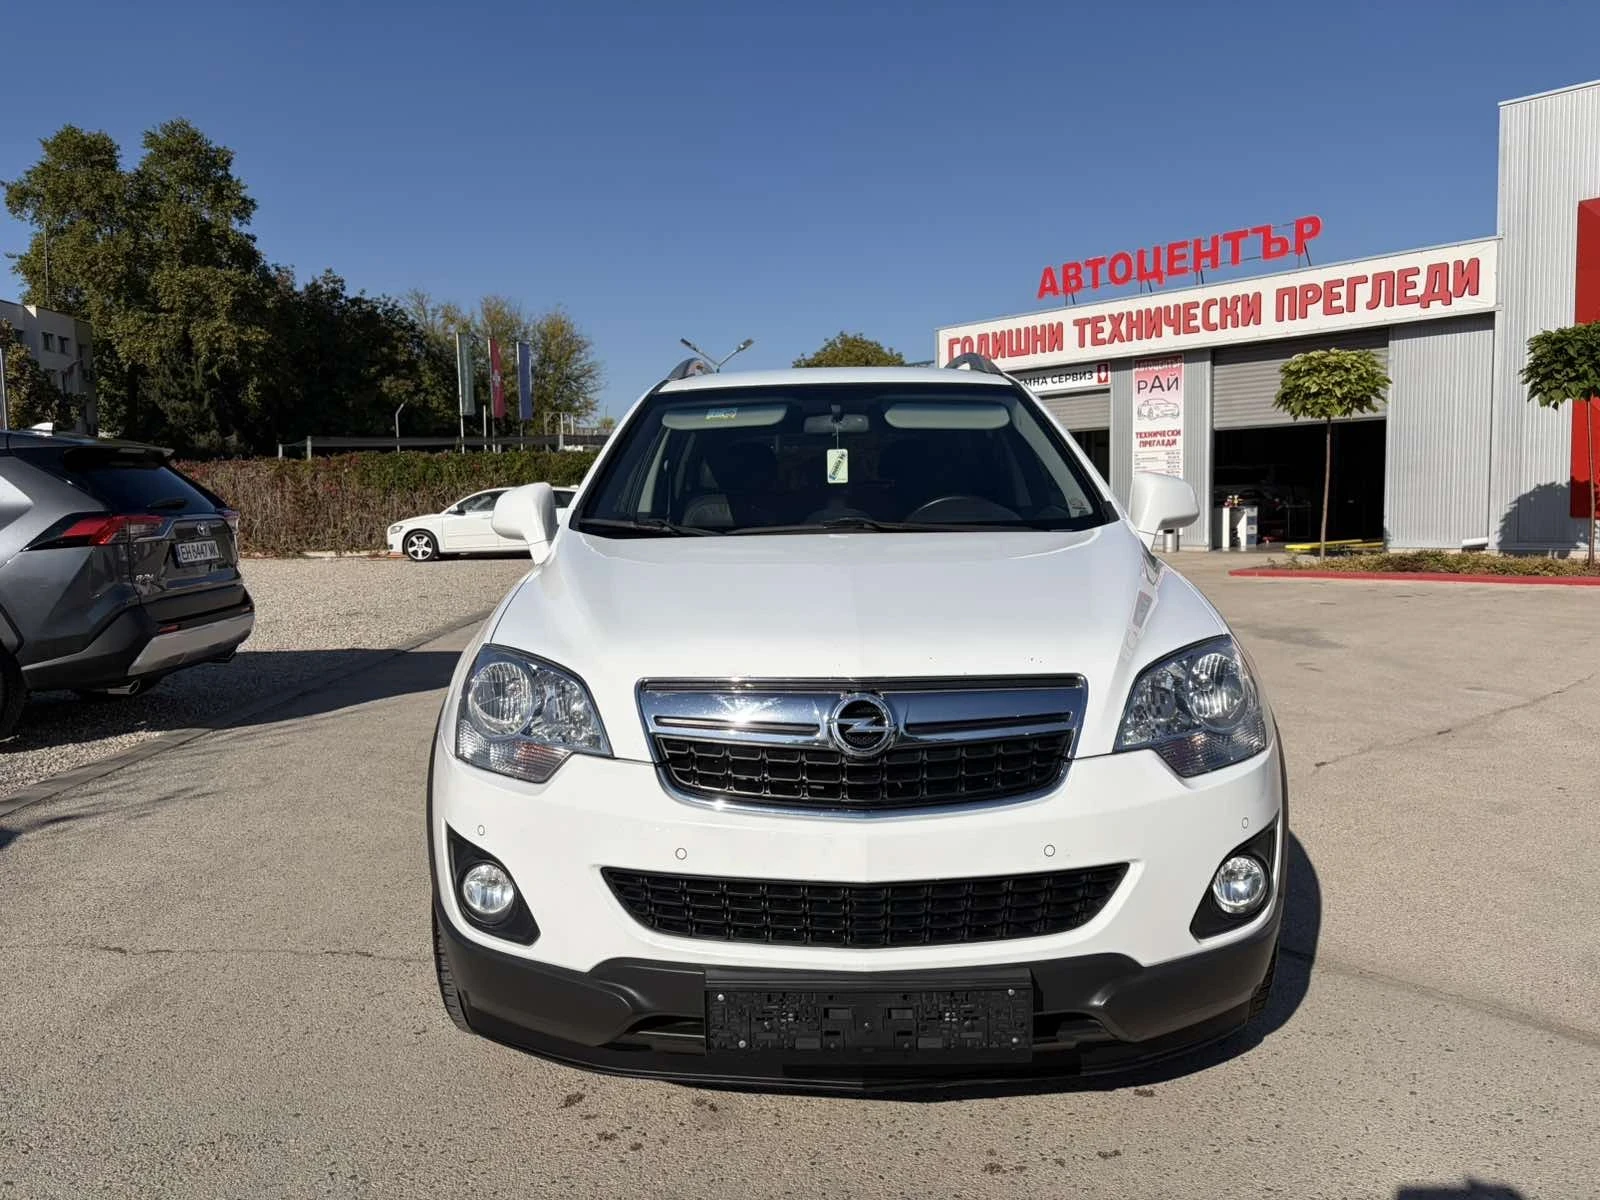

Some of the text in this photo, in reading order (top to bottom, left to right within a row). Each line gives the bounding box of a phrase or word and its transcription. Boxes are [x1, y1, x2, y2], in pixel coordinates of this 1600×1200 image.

[1037, 215, 1323, 299] АВТОЦЕНТЪР
[948, 257, 1480, 364] ГОДИШНИ ТЕХНИЧЕСКИ ПРЕГЛЕДИ
[1051, 370, 1094, 384] СЕРВИЗ
[1137, 373, 1179, 394] РАЙ
[1135, 429, 1182, 439] ТЕХНИЧЕСКИ
[1139, 439, 1177, 448] ПРЕГЛЕДИ
